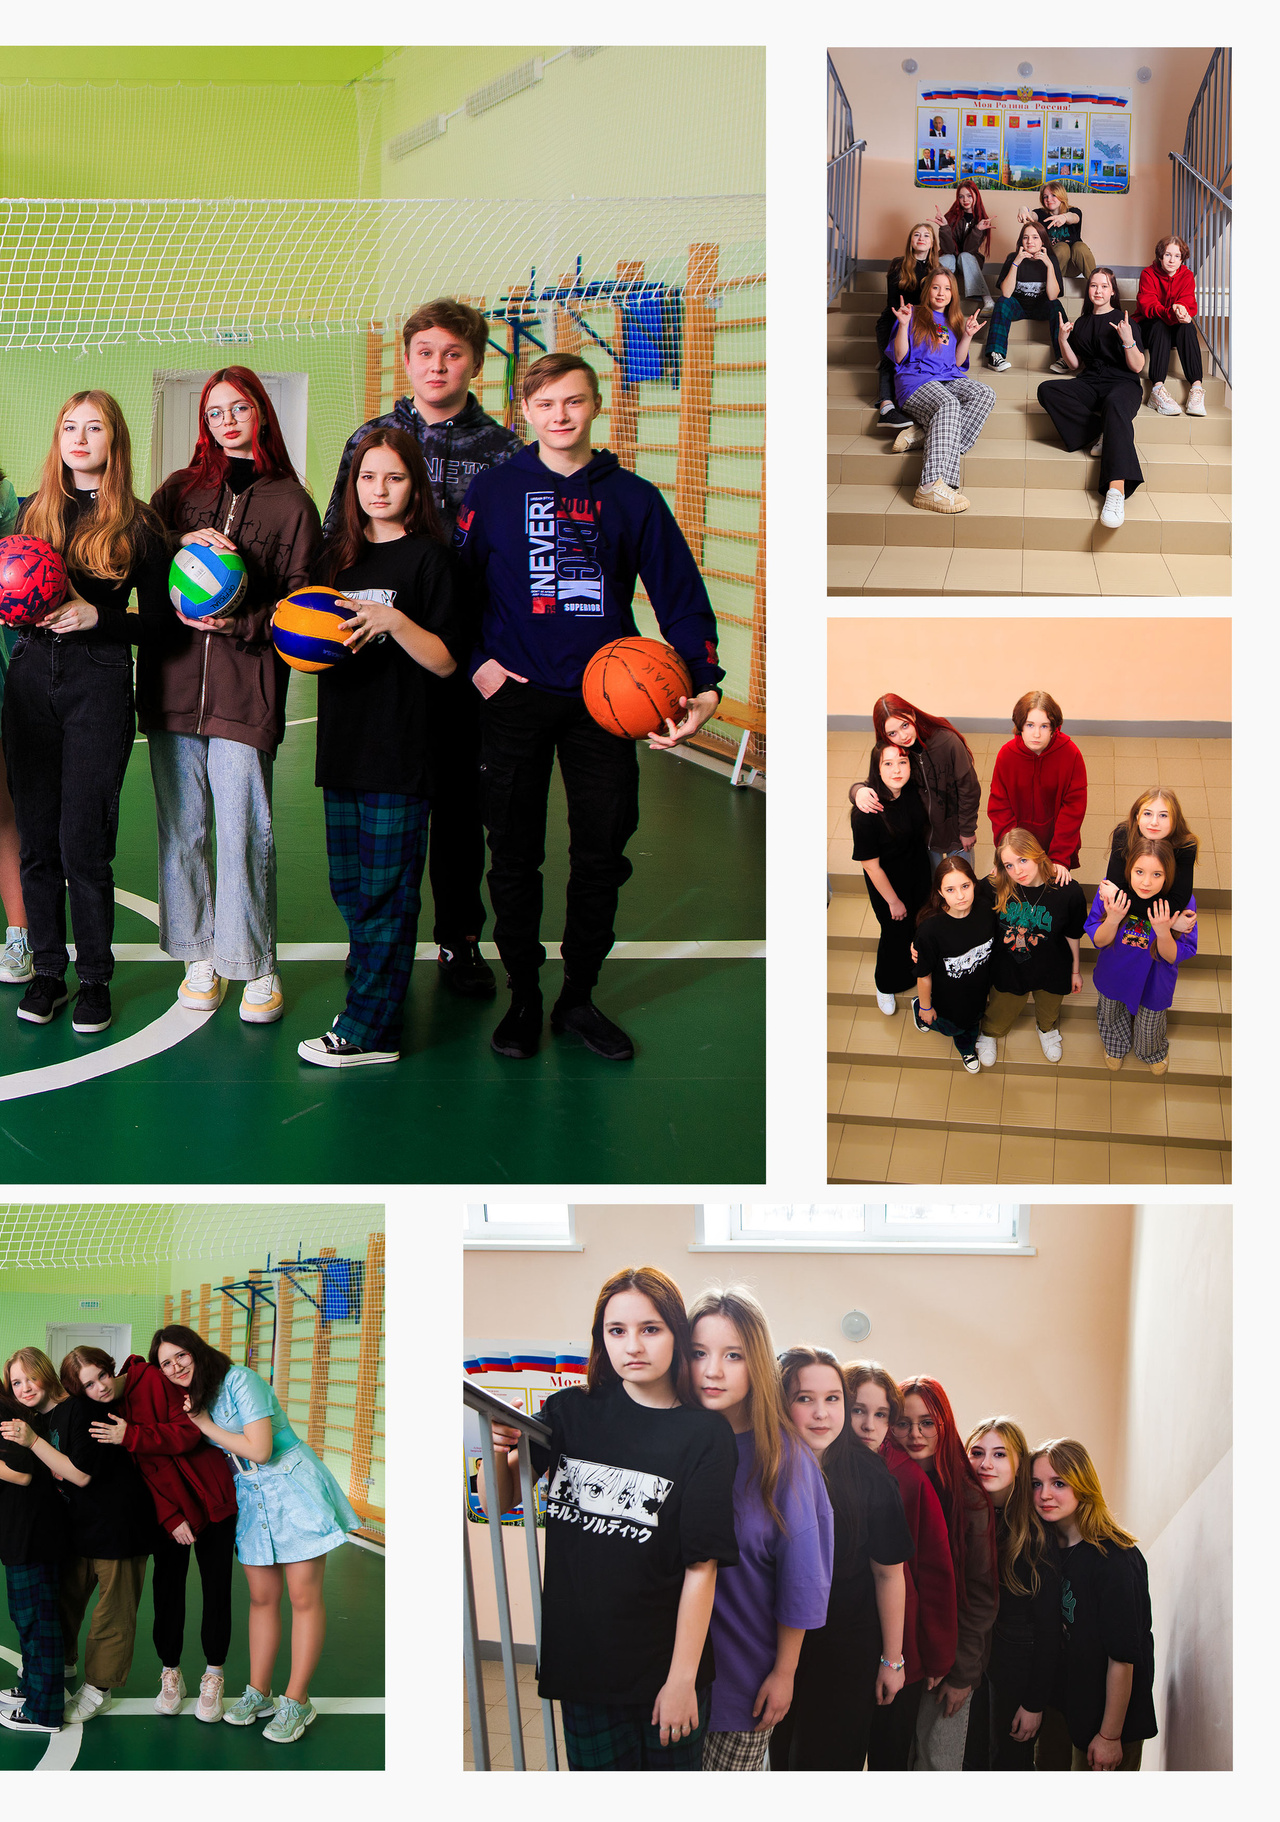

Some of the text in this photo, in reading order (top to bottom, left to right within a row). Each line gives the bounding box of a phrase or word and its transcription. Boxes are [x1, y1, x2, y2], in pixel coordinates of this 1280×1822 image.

[996, 102, 1029, 110] Родина
[1035, 103, 1071, 111] Россия!
[529, 501, 556, 591] NEVER
[210, 584, 236, 609] OFFICIAL
[564, 603, 601, 612] SUPERIOR
